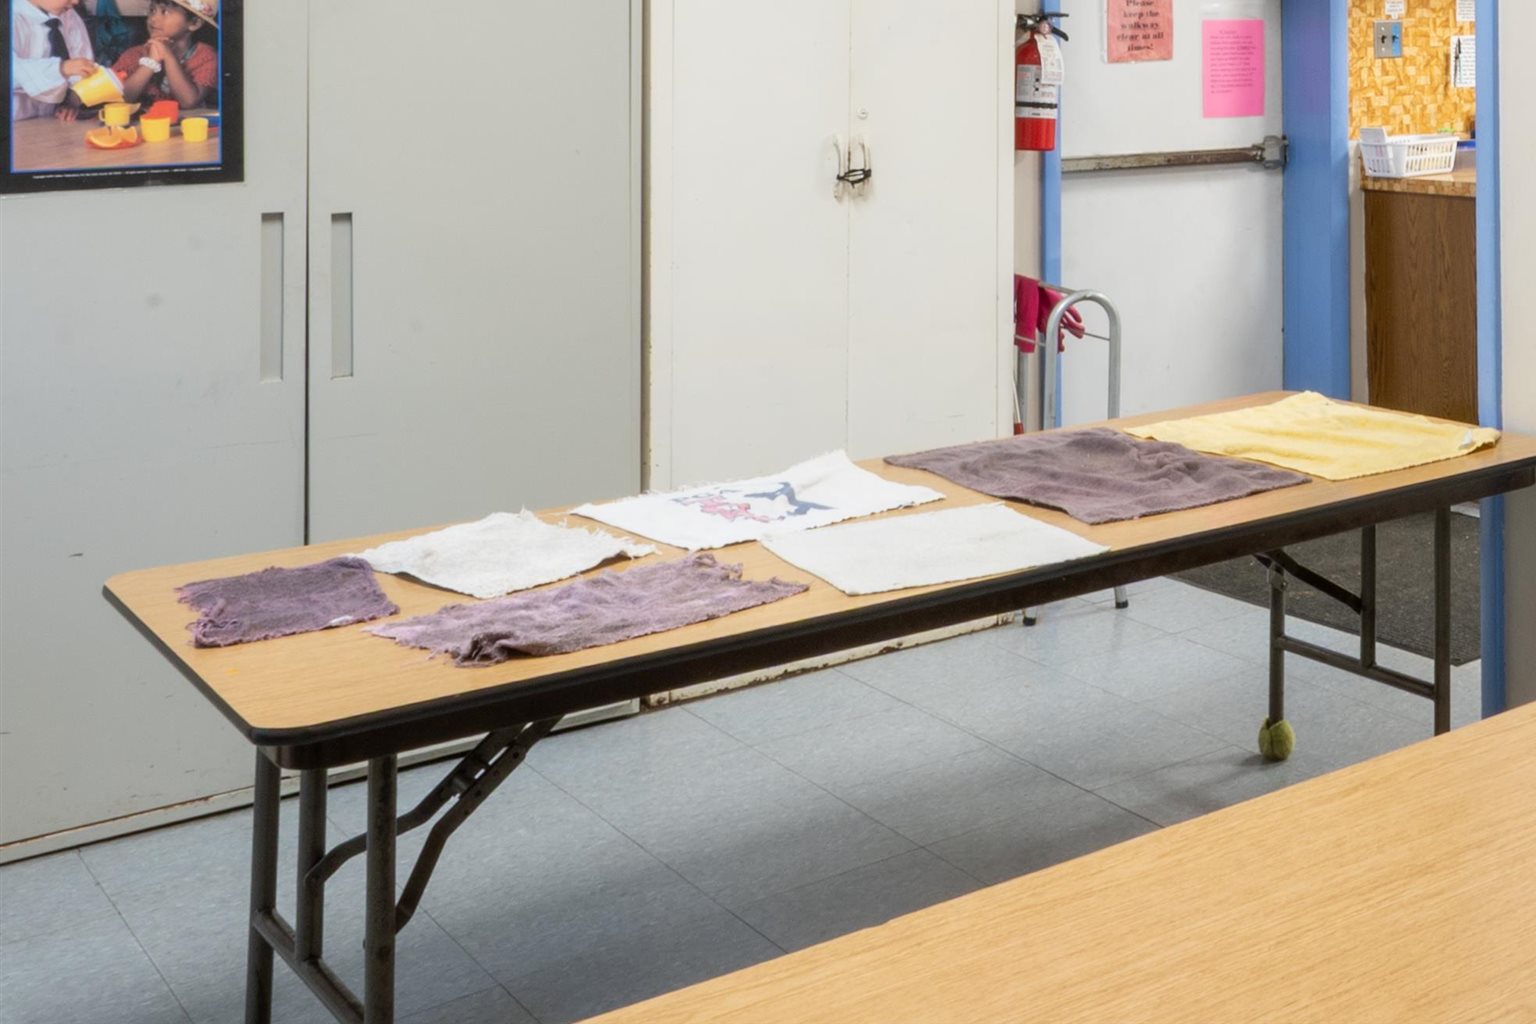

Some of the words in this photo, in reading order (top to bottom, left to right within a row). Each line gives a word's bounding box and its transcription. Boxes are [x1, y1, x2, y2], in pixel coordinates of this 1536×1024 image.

[1126, 0, 1154, 7] Please
[1123, 10, 1144, 20] keep
[1121, 21, 1159, 30] walkway
[1116, 33, 1139, 41] clear
[1152, 32, 1164, 40] all
